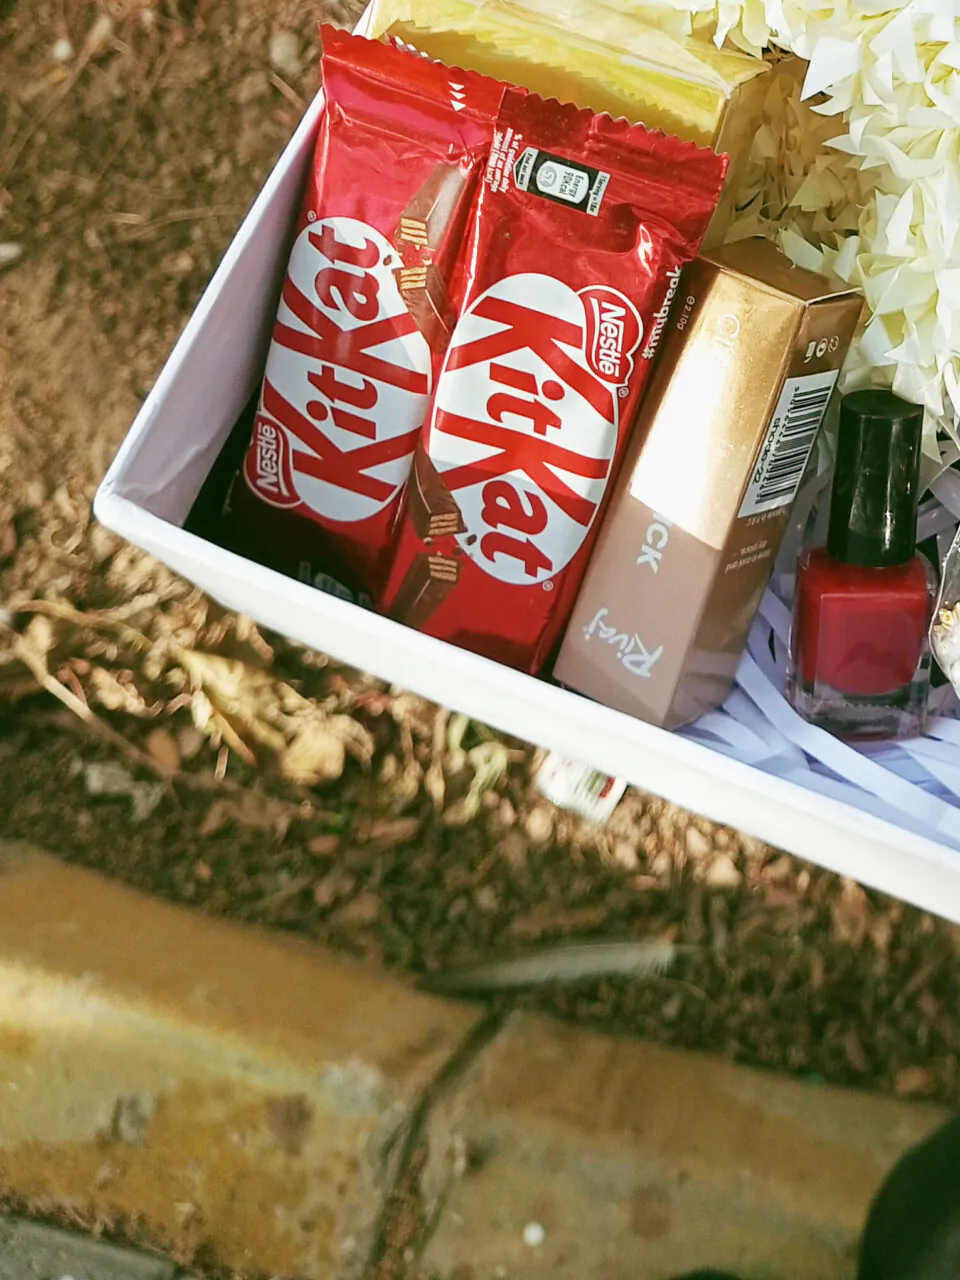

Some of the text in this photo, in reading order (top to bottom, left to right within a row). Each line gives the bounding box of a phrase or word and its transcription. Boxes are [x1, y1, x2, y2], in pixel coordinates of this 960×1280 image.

[572, 175, 584, 198] Energy
[263, 225, 429, 501] KitKat
[599, 301, 628, 378] Nestlé
[256, 423, 280, 493] Nestlé
[434, 295, 614, 577] KitKat
